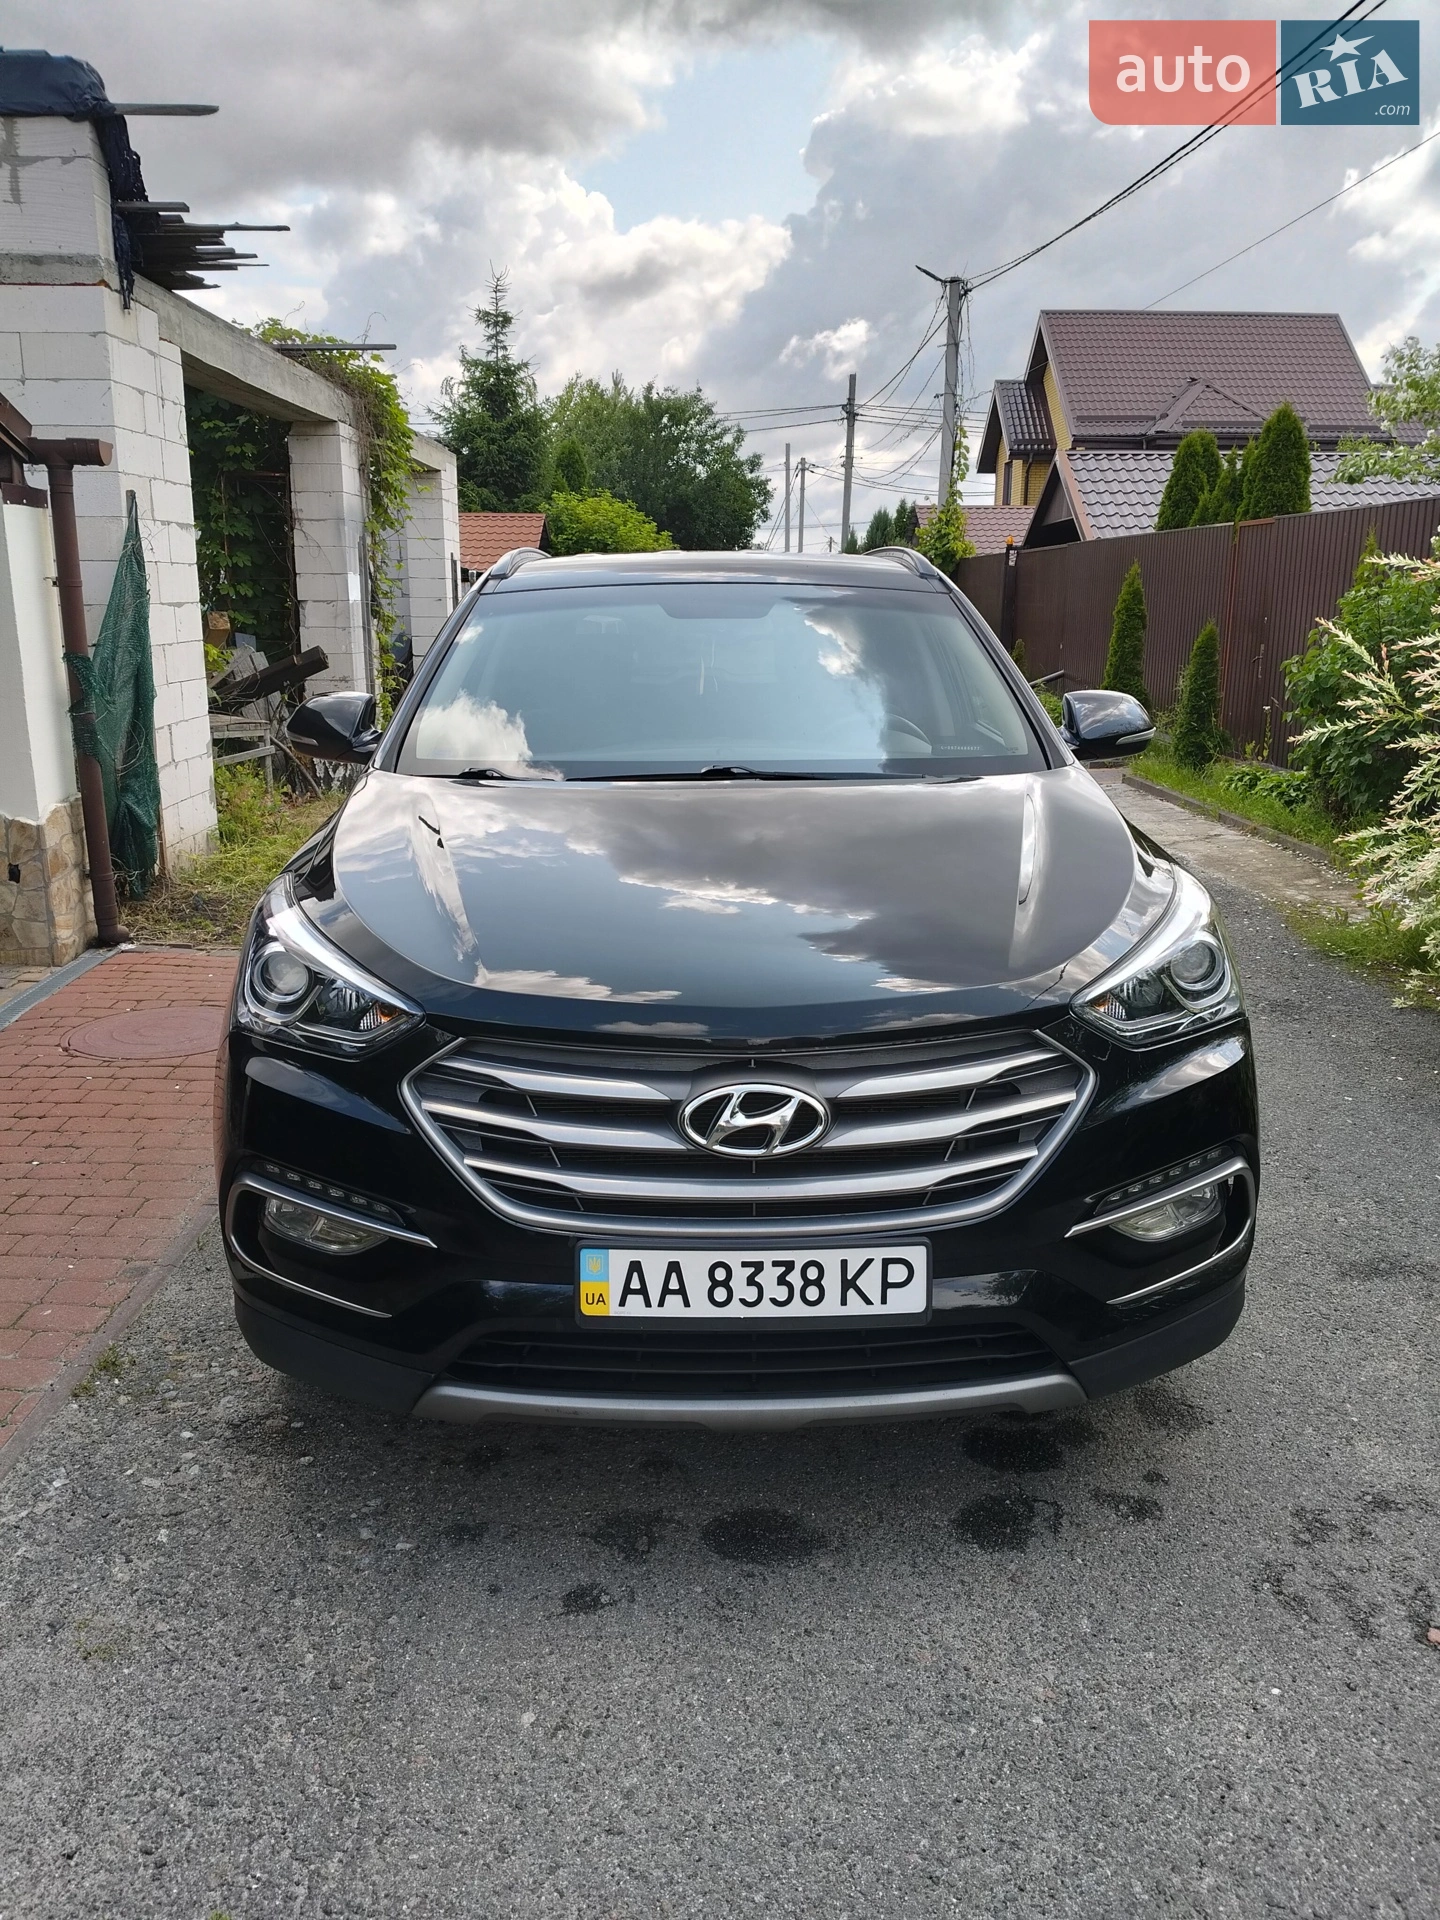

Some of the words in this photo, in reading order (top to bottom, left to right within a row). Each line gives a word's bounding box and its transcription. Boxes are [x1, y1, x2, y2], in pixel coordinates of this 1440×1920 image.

[618, 1259, 692, 1308] AA
[707, 1259, 826, 1308] 8338
[839, 1257, 915, 1306] KP
[585, 1292, 607, 1306] UA
